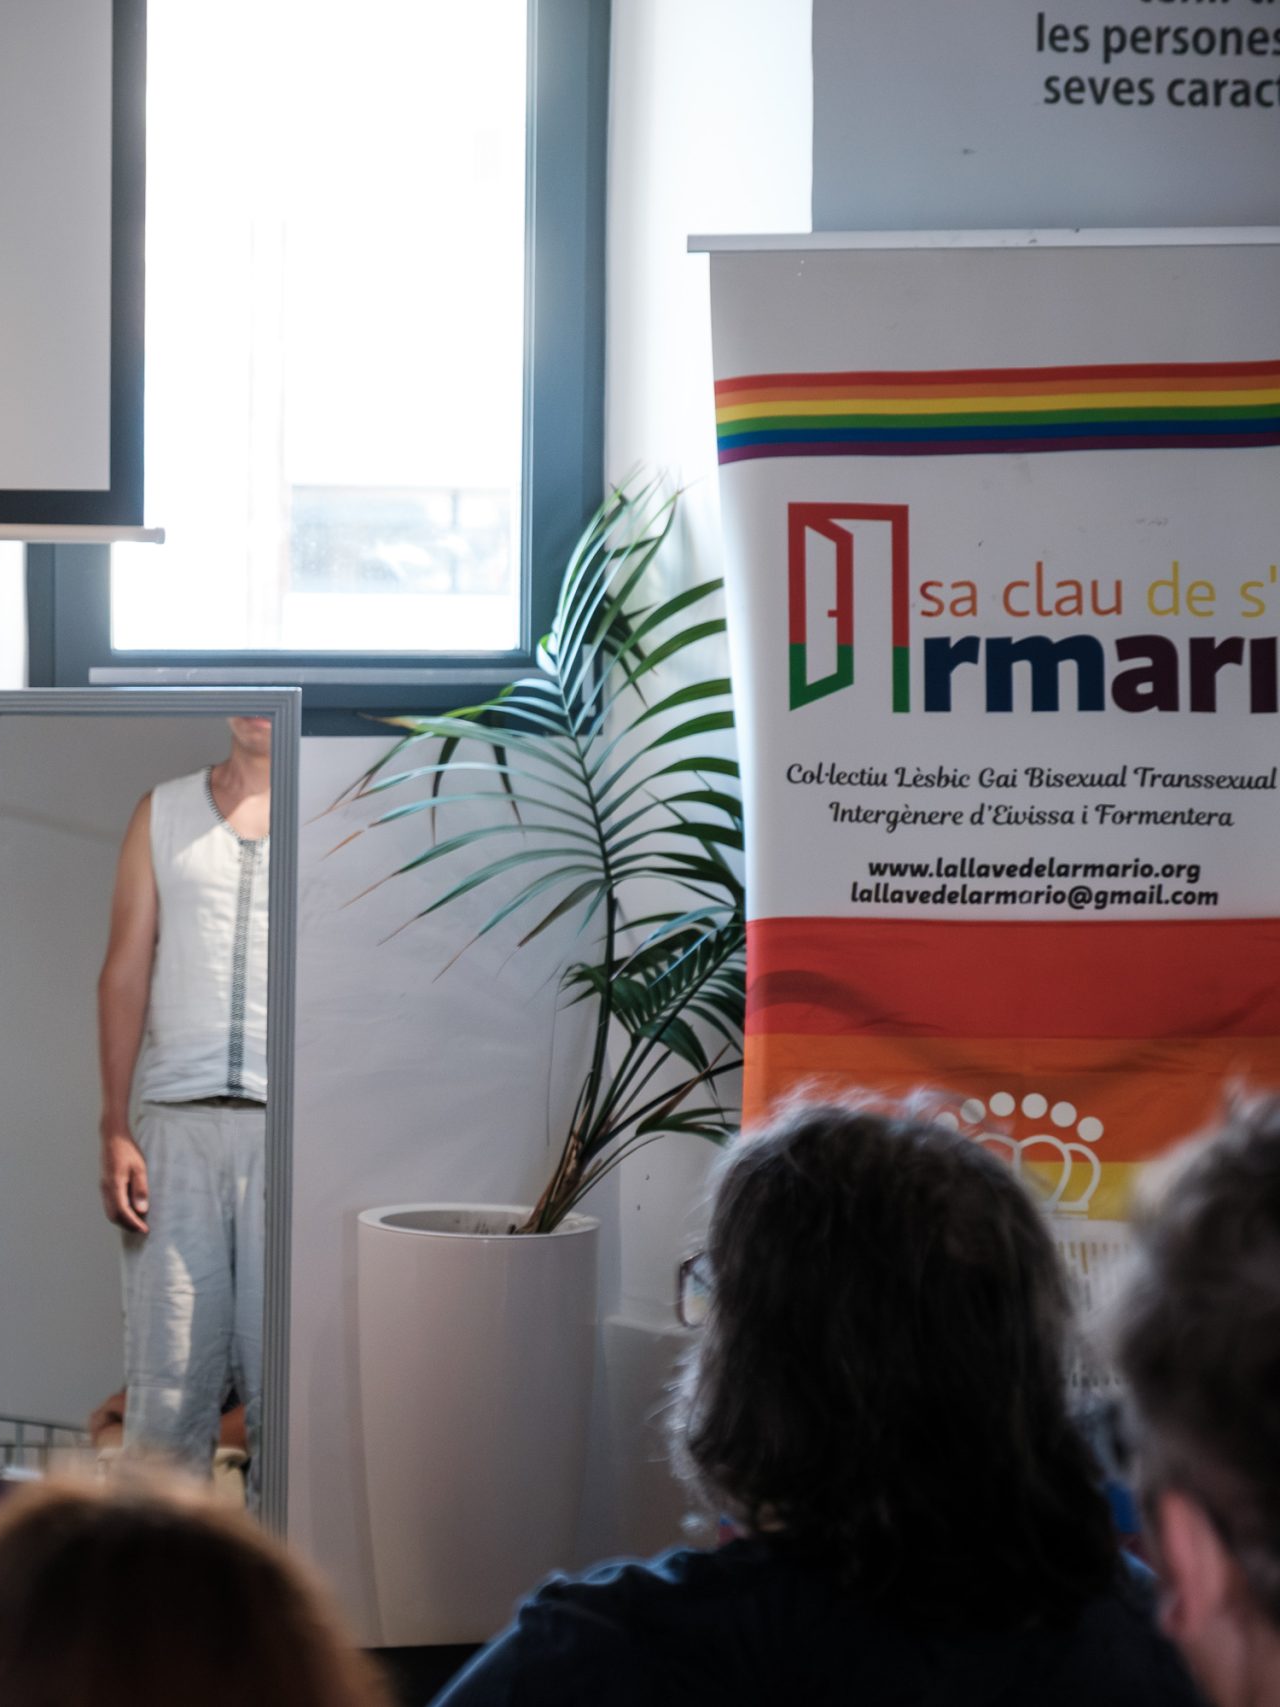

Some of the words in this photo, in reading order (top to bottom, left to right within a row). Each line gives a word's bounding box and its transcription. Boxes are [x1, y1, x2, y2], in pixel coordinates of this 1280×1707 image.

[1036, 12, 1090, 53] les
[1043, 76, 1155, 106] seves
[919, 580, 978, 618] sa
[1002, 560, 1123, 618] clau
[1146, 560, 1217, 618] de
[894, 766, 971, 788] Lèsbic
[978, 767, 1018, 788] Gai
[1023, 764, 1128, 788] Bisexual
[1132, 766, 1278, 790] Transsexual
[828, 801, 964, 833] Intergènere
[1081, 804, 1089, 825] i
[1094, 803, 1235, 827] Formentera
[868, 856, 1201, 883] www.lallavedelarmario.org
[850, 882, 1219, 910] lallavedelarmario@gmail.com
